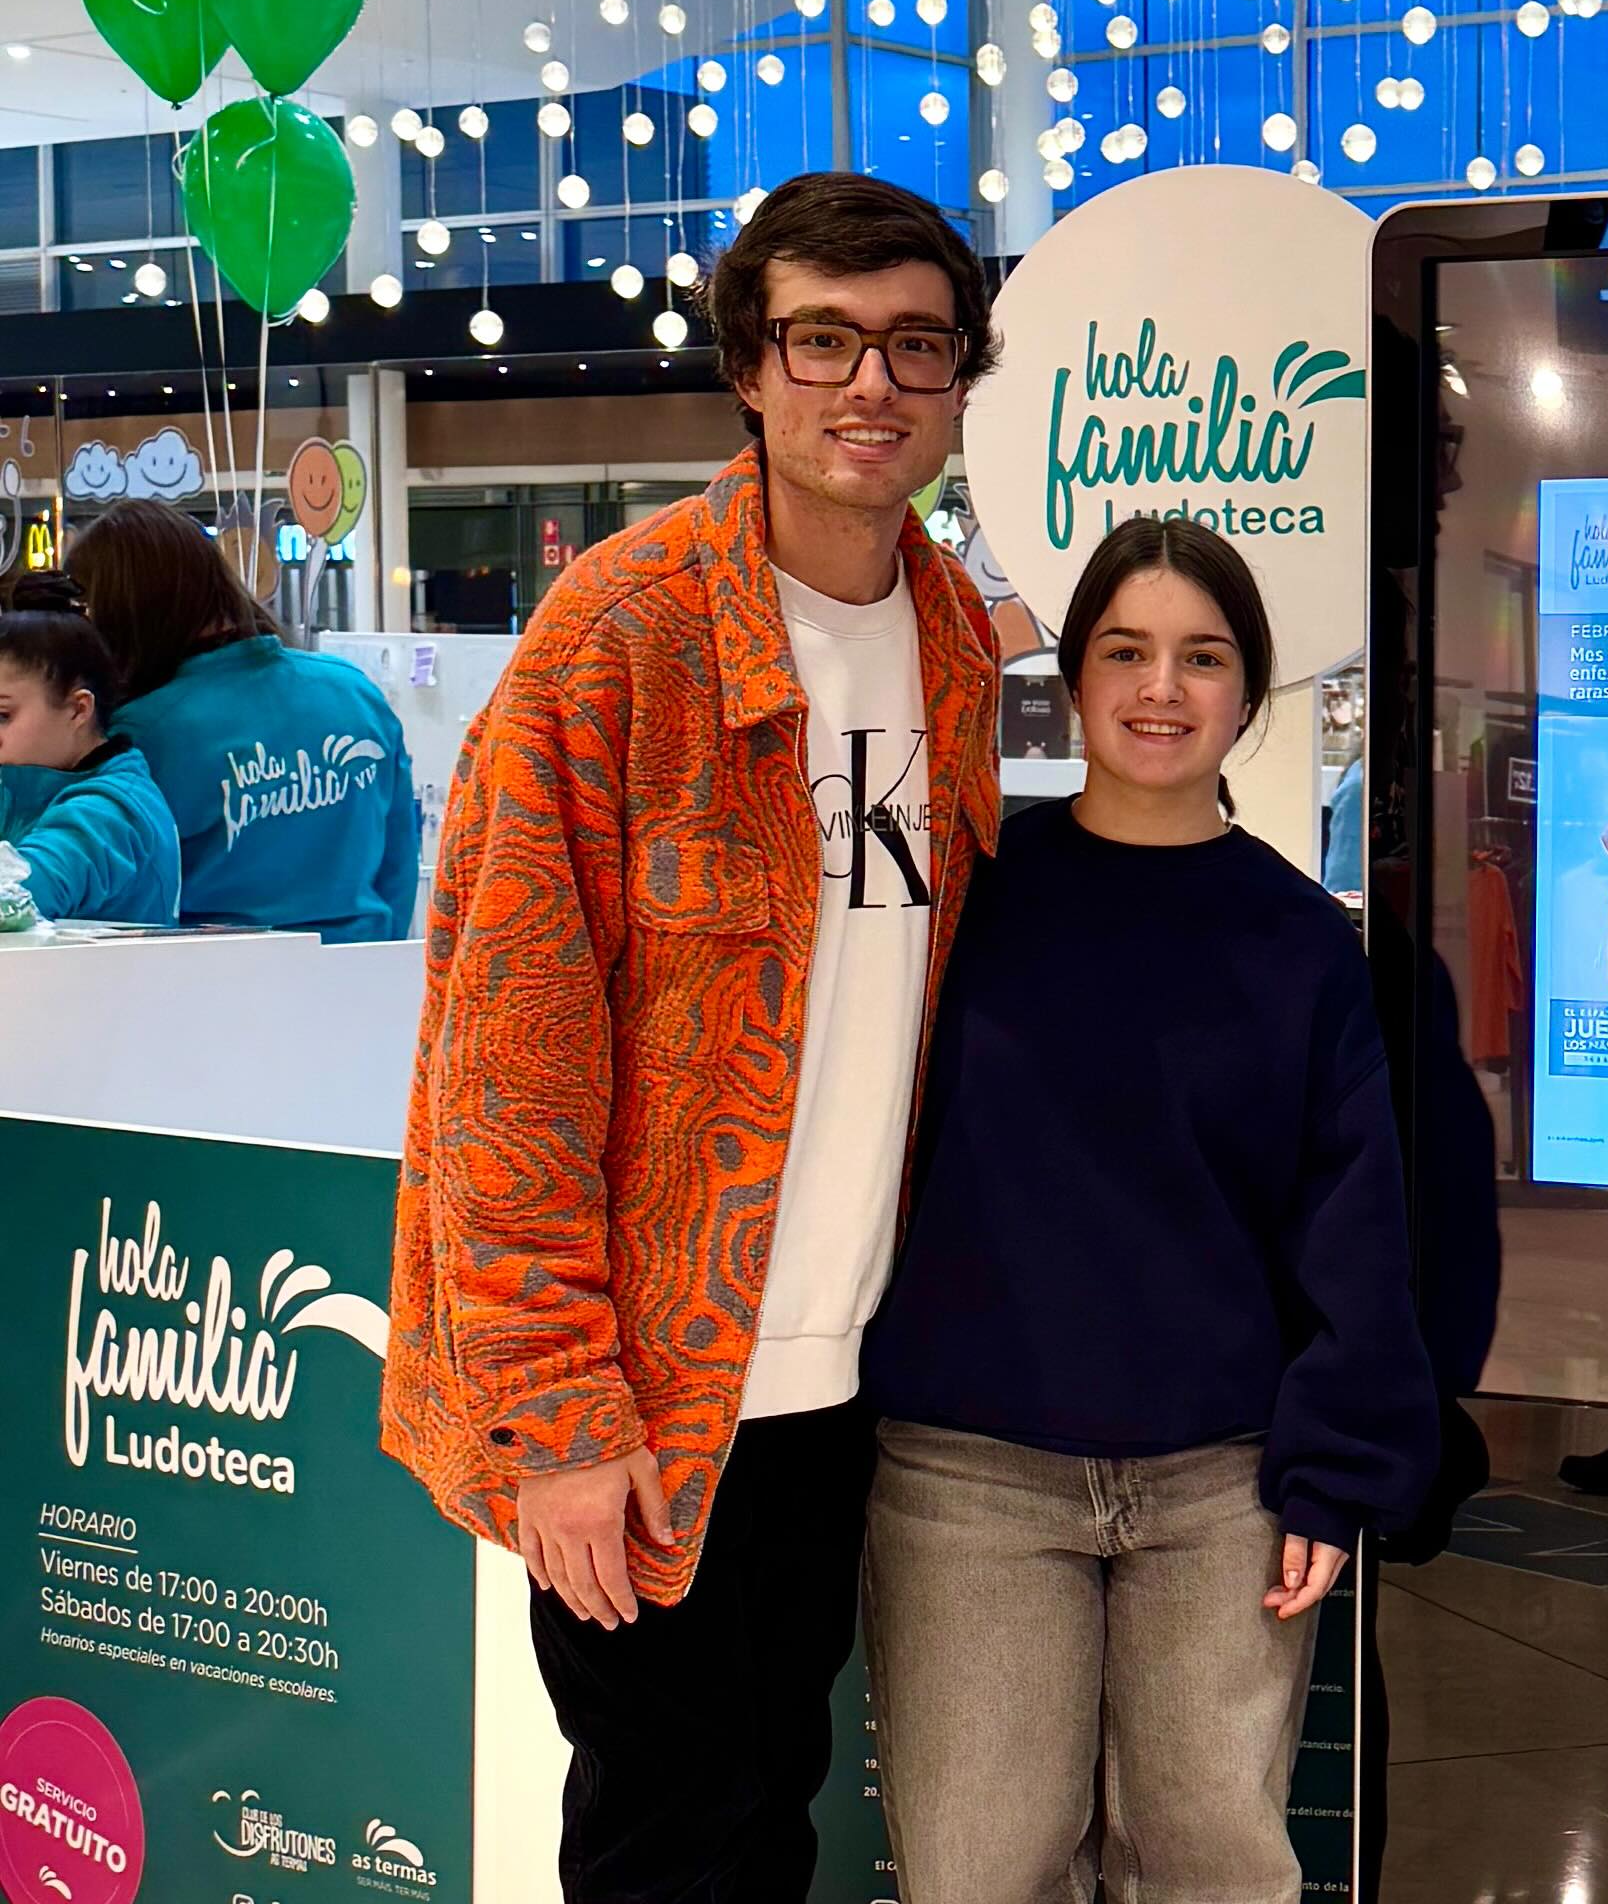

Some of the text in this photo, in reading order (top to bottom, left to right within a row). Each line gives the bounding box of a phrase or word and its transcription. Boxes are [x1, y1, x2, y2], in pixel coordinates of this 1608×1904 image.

[1087, 317, 1190, 400] hola
[1047, 354, 1314, 550] familia
[1570, 648, 1604, 663] Mes
[228, 741, 286, 789] hola
[1563, 1039, 1586, 1050] LOS
[100, 1197, 189, 1302] hola
[65, 1248, 297, 1467] familia
[106, 1415, 295, 1494] Ludoteca
[40, 1503, 137, 1541] HORARIO
[41, 1548, 328, 1627] Viernes de 17:00 a 20:00h
[41, 1587, 339, 1670] Sábados de 17:00 a 20:30h
[41, 1627, 338, 1704] Horarios especiales en vacaciones escolares.
[0, 1782, 127, 1874] GRATUITO
[36, 1777, 97, 1822] SERVICIO
[1298, 1807, 1313, 1816] del
[241, 1818, 336, 1865] DISFRUTONES
[352, 1853, 437, 1886] as termas
[1323, 1882, 1337, 1892] de
[1339, 1882, 1349, 1893] la
